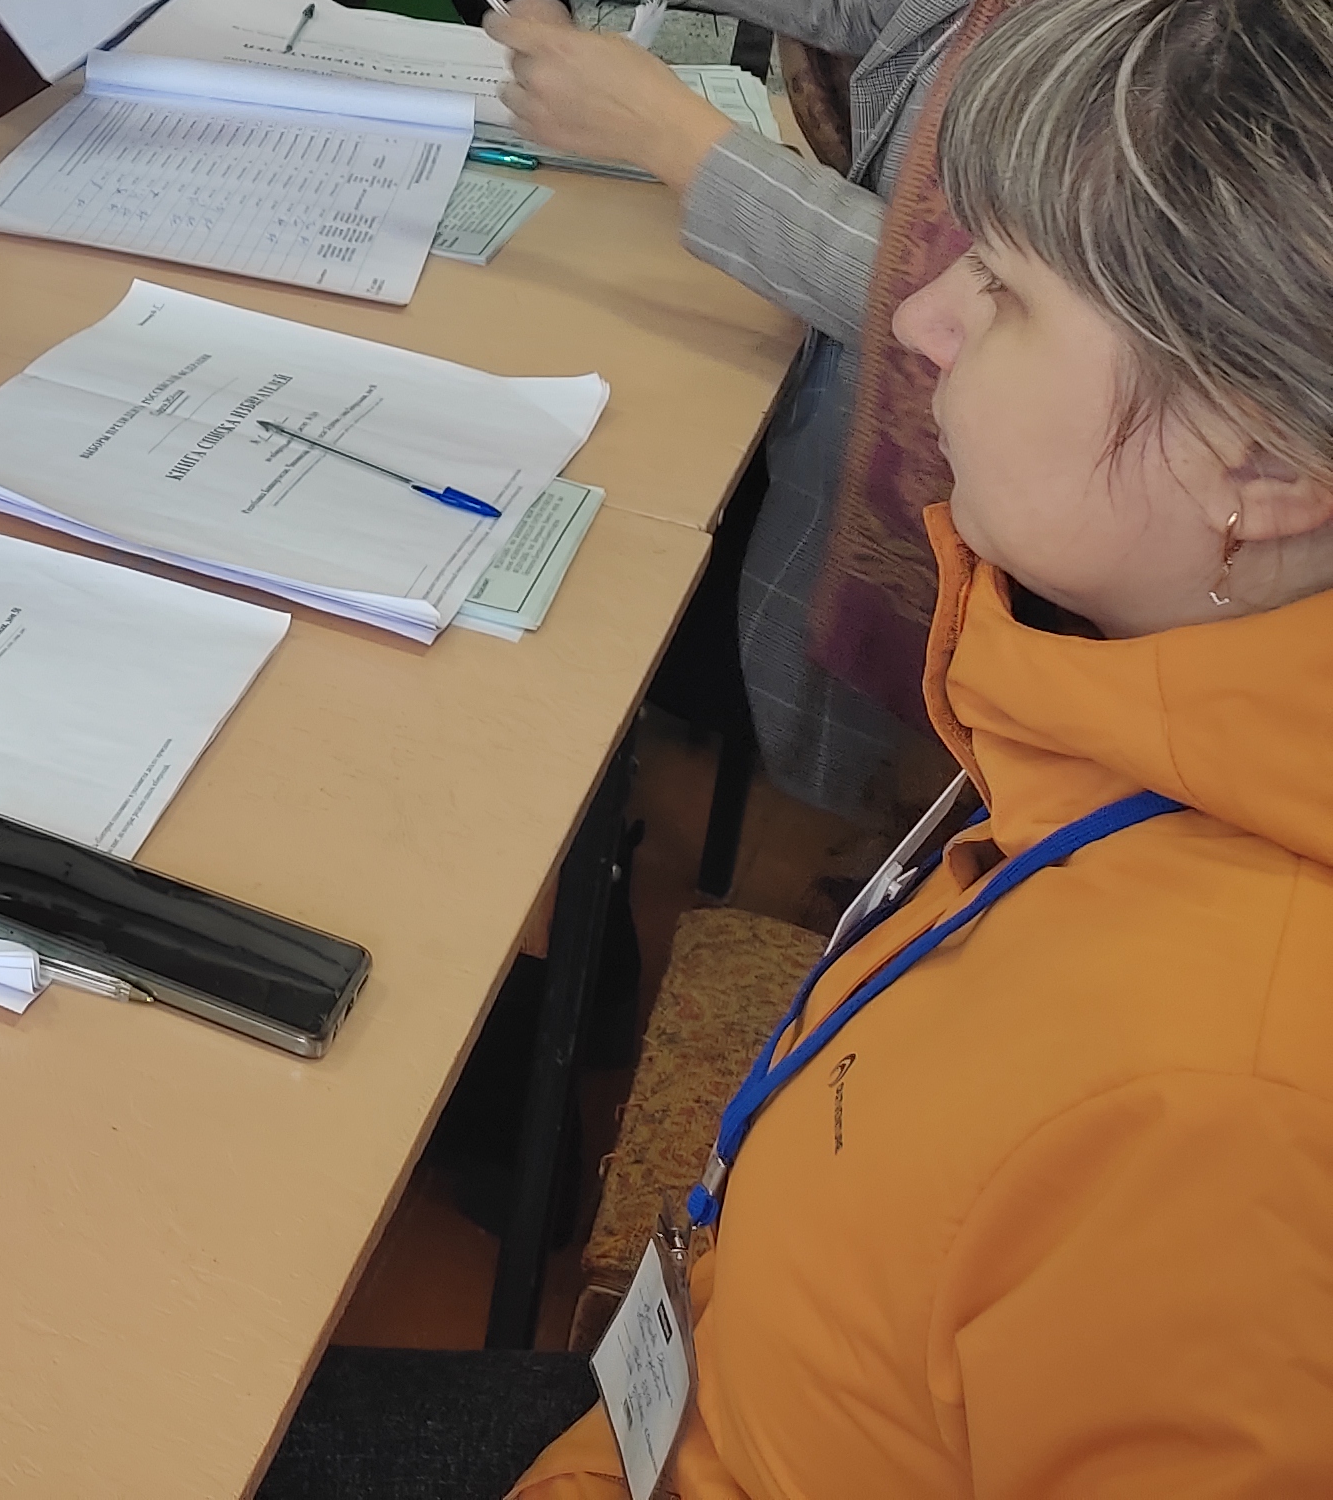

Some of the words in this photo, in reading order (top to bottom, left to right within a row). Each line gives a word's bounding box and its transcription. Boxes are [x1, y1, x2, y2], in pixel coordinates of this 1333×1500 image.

[164, 447, 208, 482] КНИГА
[194, 417, 242, 450] СПИСКА
[228, 372, 294, 419] ИЗБИРАТЕЛЕЙ
